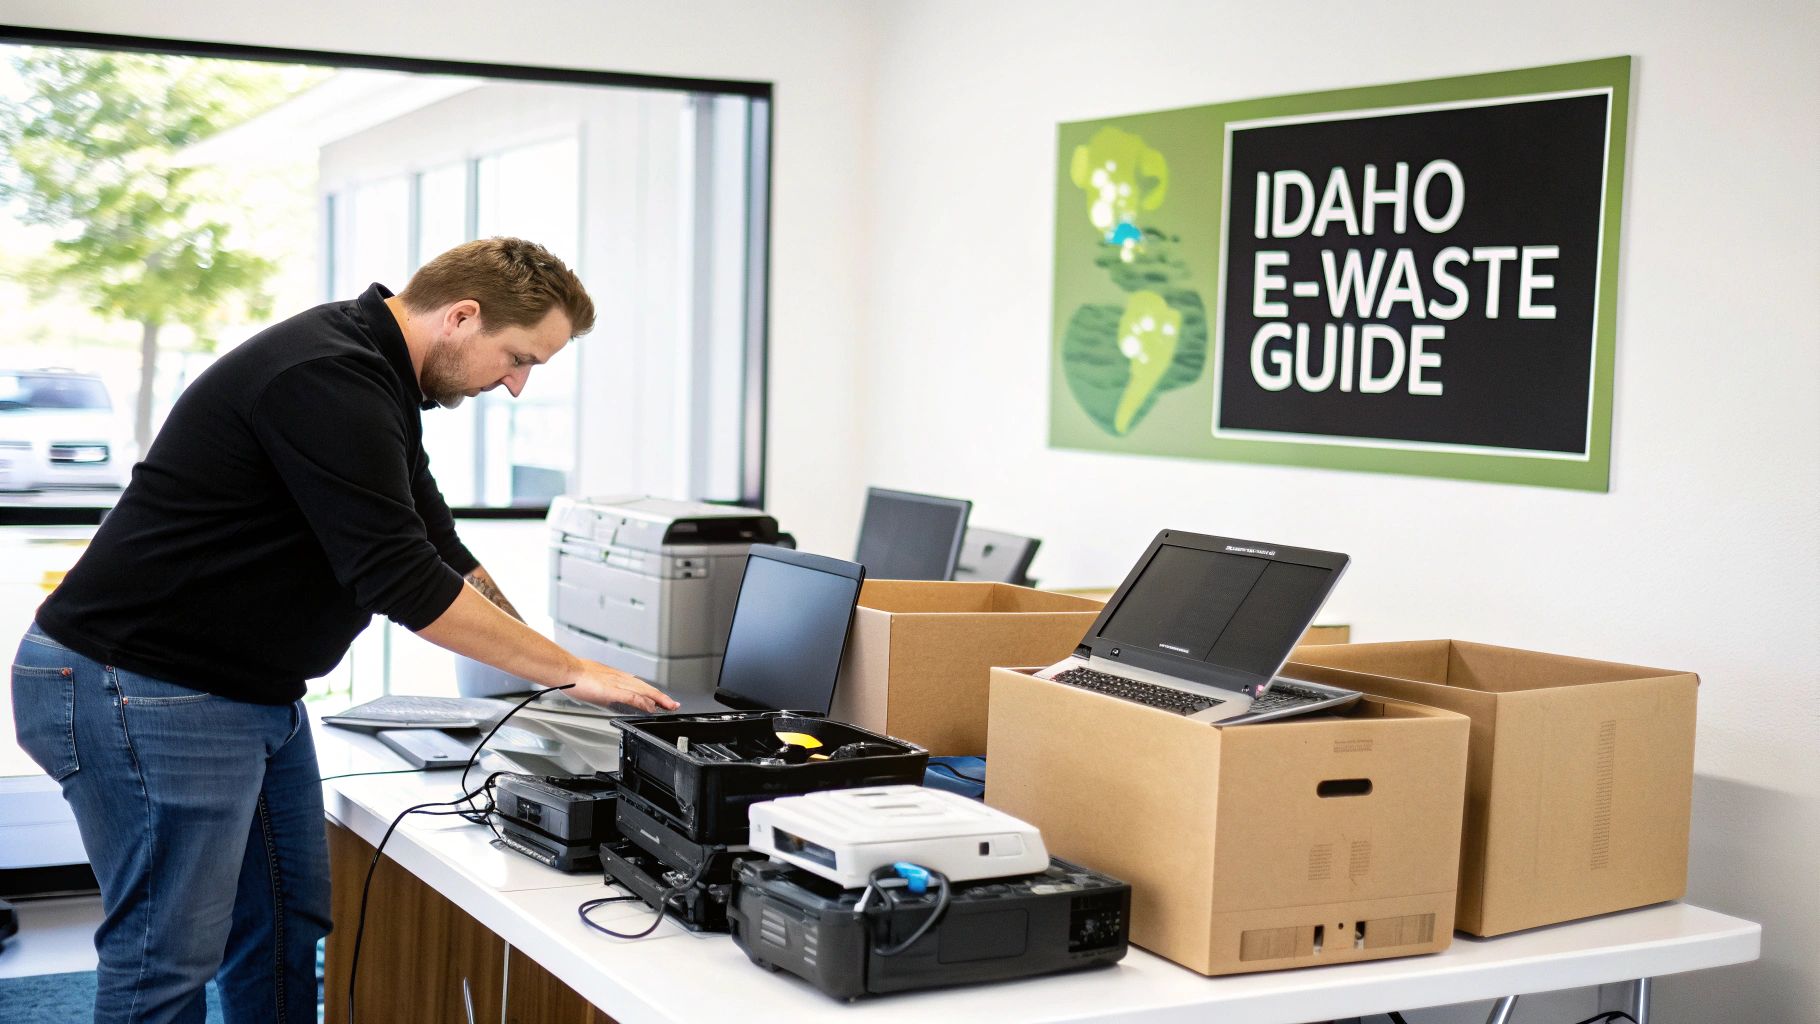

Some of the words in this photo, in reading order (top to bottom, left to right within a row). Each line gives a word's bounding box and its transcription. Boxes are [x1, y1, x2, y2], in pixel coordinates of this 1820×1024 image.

[1254, 159, 1465, 239] IDAHO
[1252, 245, 1560, 320] E-WASTE
[1250, 321, 1446, 396] GUIDE
